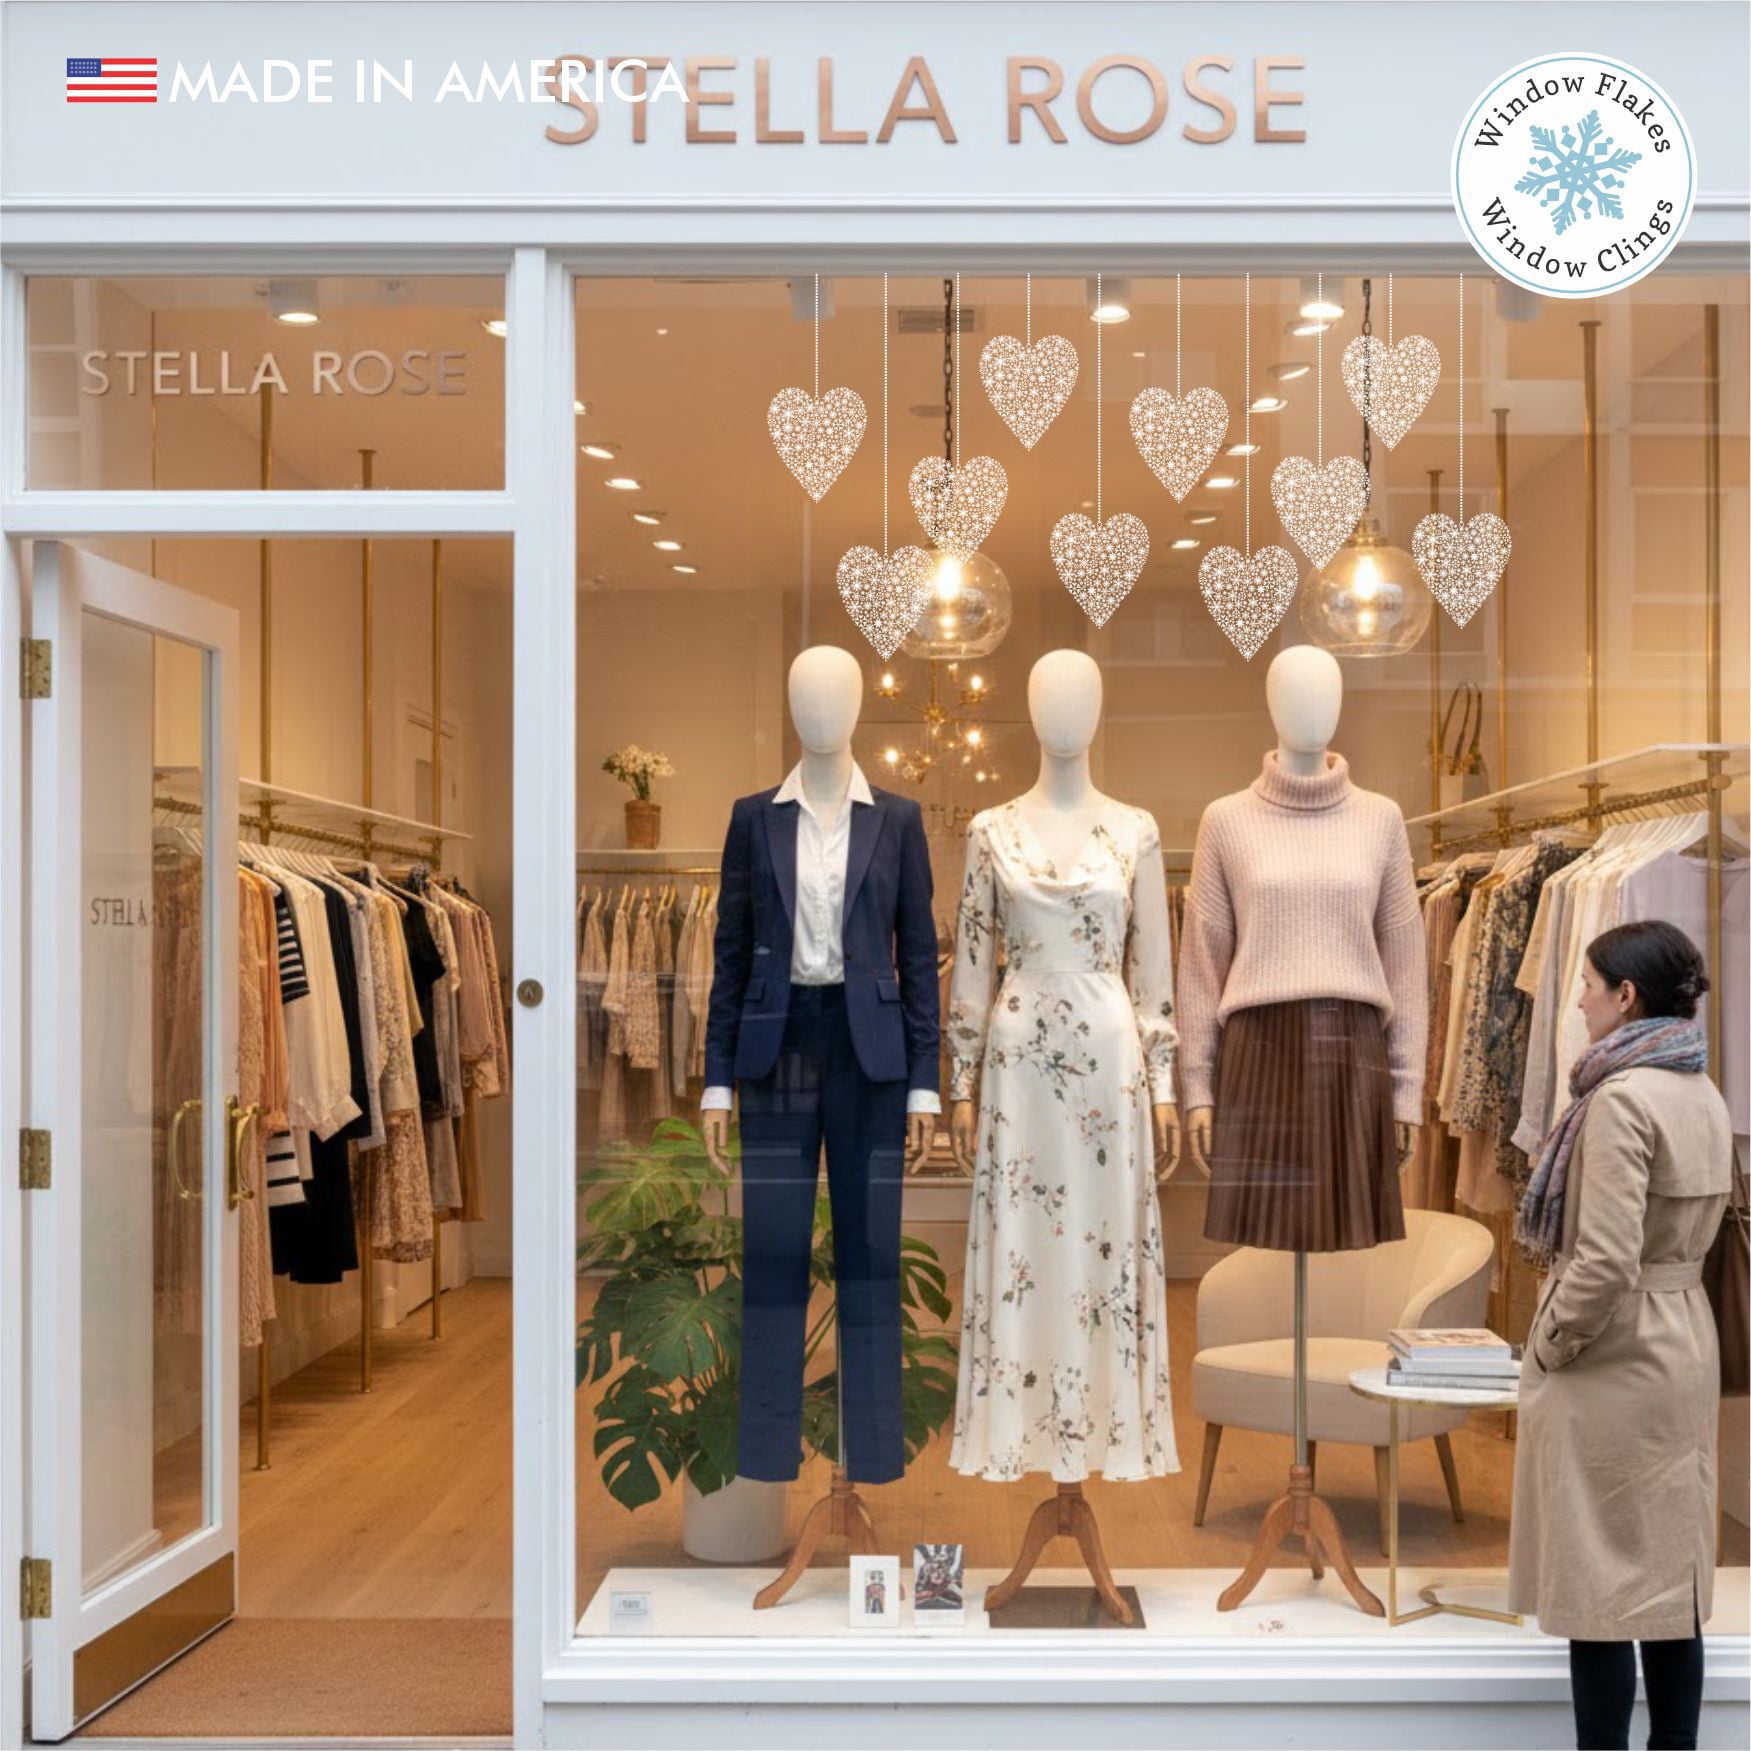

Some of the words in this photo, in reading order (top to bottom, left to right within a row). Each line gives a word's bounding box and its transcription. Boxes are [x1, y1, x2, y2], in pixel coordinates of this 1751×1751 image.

[544, 53, 958, 146] STELLA
[1007, 53, 1308, 146] ROSE
[81, 350, 290, 395] STELLA
[312, 350, 467, 395] ROSE
